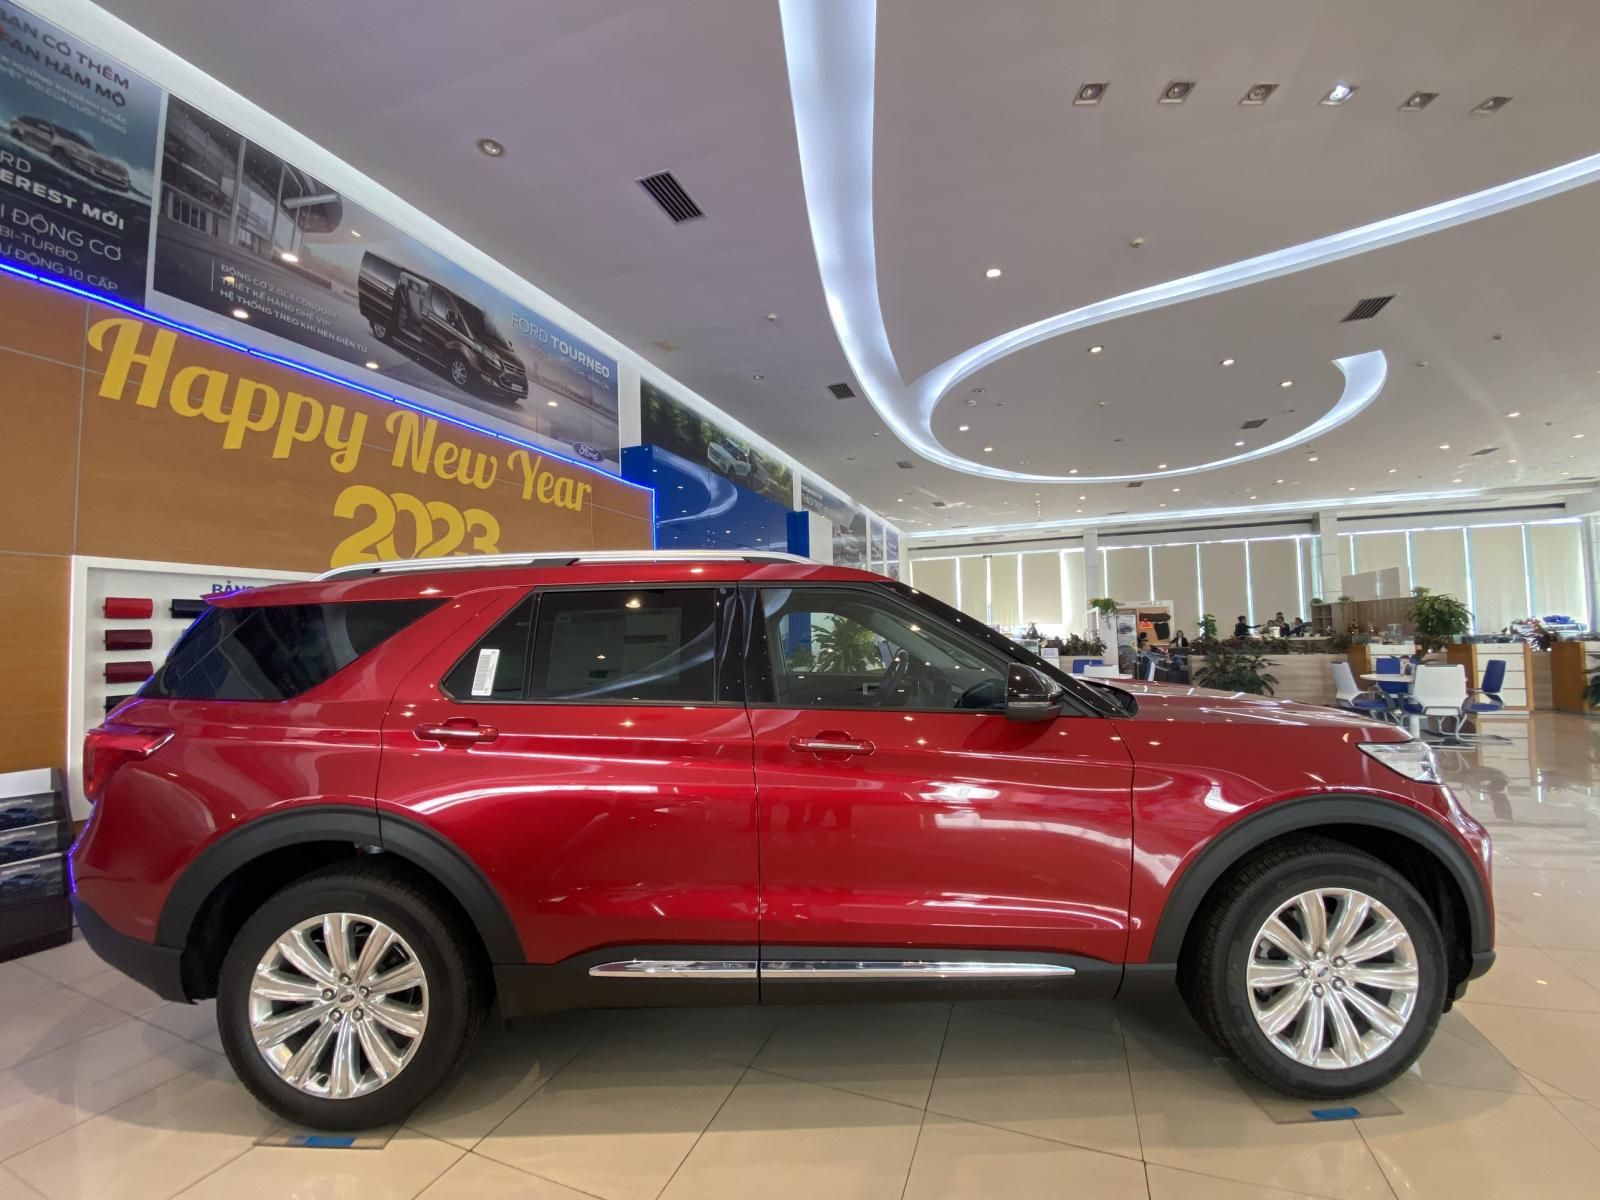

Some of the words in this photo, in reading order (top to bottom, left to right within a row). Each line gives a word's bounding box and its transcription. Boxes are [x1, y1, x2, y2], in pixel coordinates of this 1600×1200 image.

[75, 51, 129, 90] THÊM
[11, 208, 84, 247] ĐỘNG
[89, 239, 121, 261] CƠ
[82, 202, 124, 230] MỚI
[68, 267, 84, 281] 10
[511, 312, 548, 344] FORD
[550, 334, 610, 379] TOURNEO
[87, 318, 368, 473] Happy
[386, 410, 498, 490] New
[507, 449, 592, 512] Year
[578, 445, 600, 461] Ford
[330, 484, 500, 568] 2023
